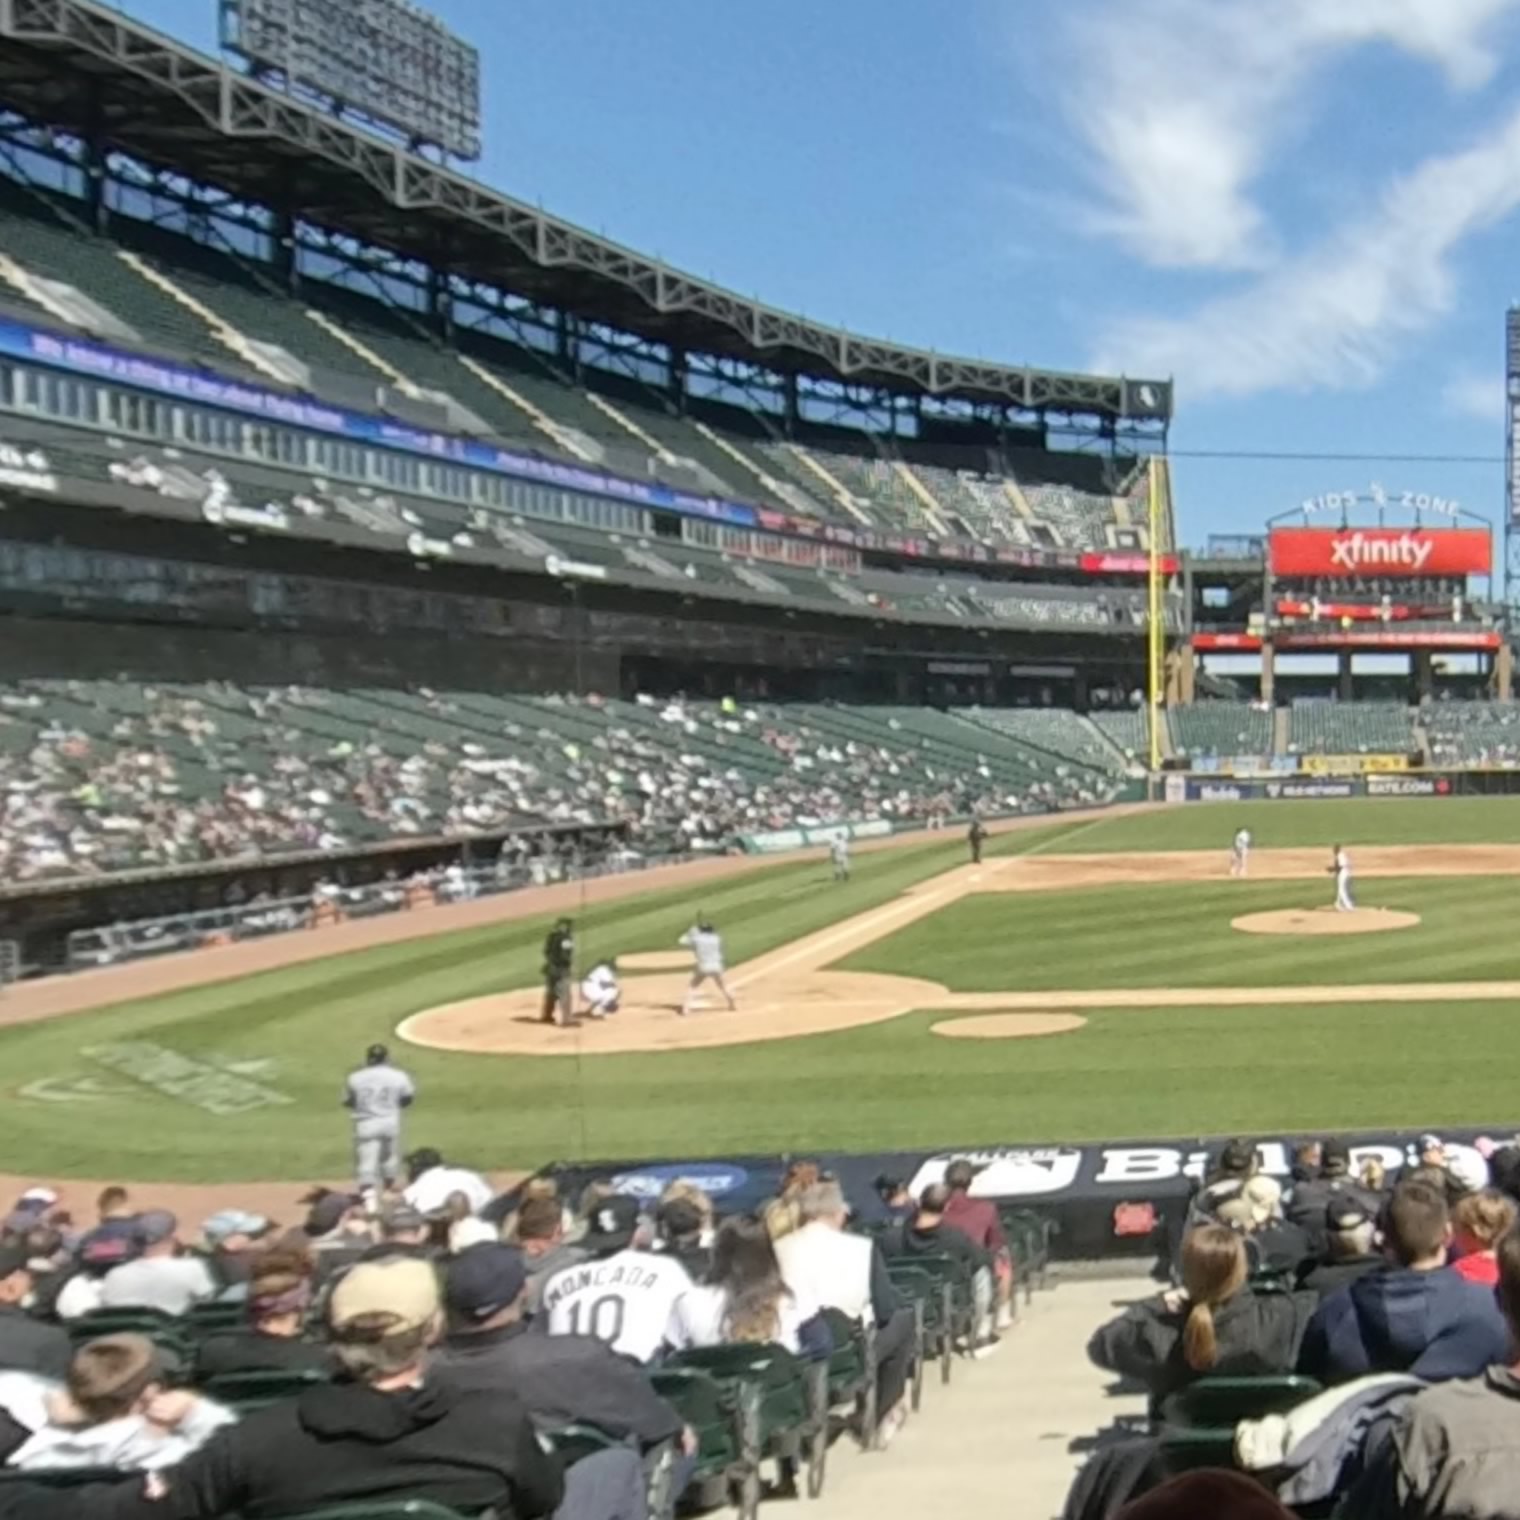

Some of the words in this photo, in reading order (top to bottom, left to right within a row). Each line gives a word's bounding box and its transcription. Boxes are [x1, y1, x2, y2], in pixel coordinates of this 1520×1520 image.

[1302, 490, 1358, 514] KIDS
[1402, 490, 1459, 516] ZONE
[1331, 533, 1433, 568] xfinity
[549, 1265, 659, 1311] MONCADA
[568, 1293, 625, 1343] 10
